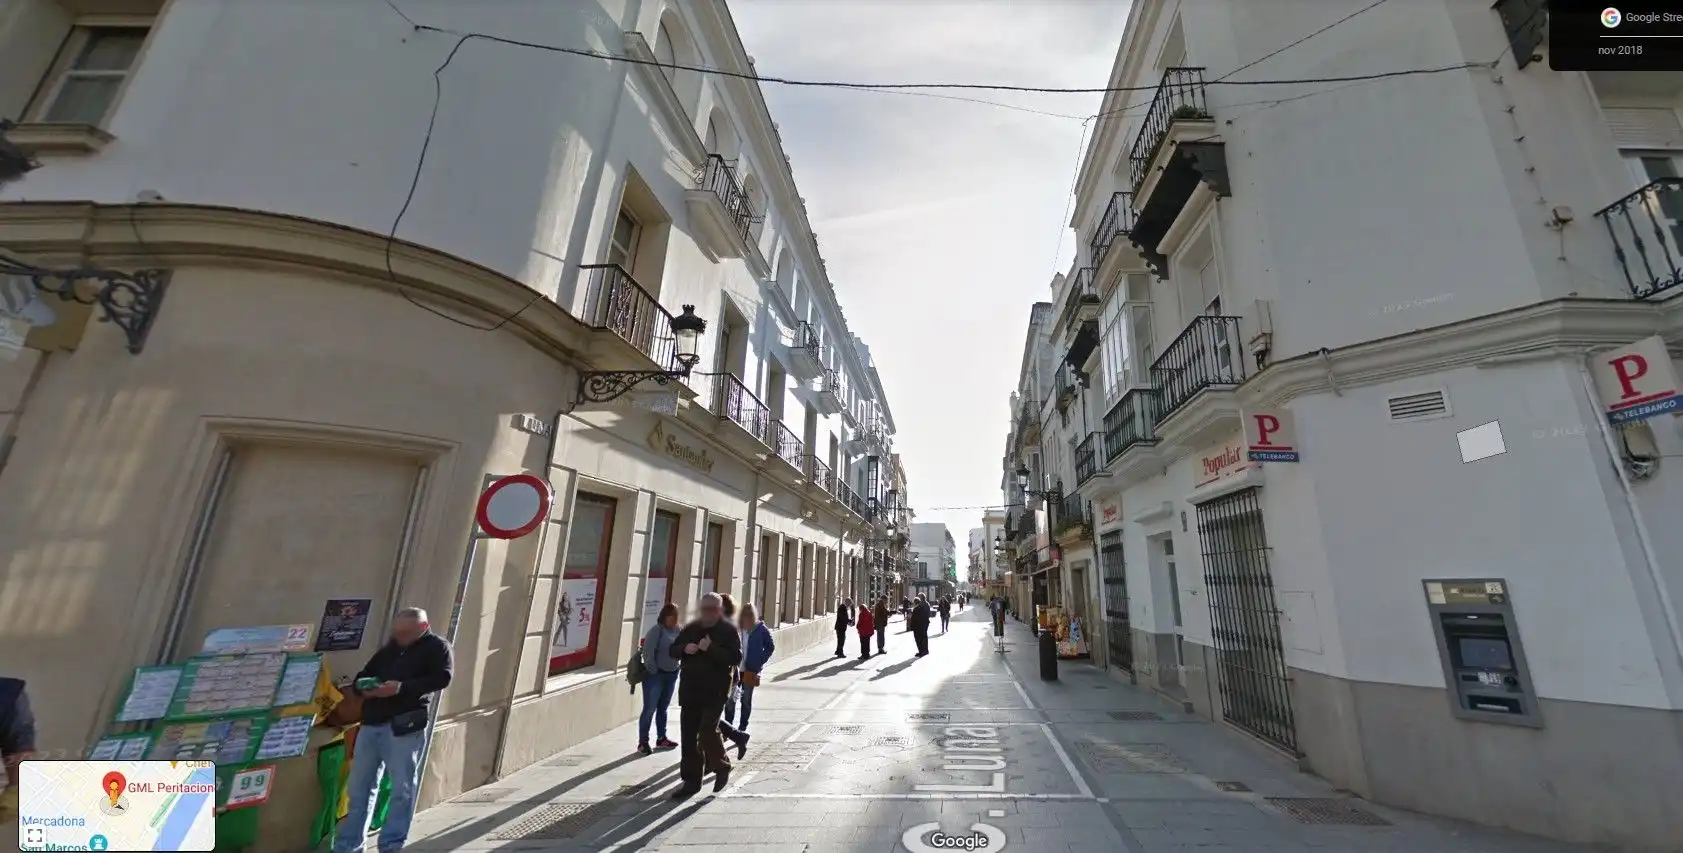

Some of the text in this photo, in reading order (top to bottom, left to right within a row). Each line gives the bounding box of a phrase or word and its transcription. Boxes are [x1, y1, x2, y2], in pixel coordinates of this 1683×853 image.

[1608, 355, 1648, 399] P
[1624, 400, 1677, 418] TELEBANCO
[1253, 415, 1280, 445] P
[1202, 446, 1241, 476] Popular
